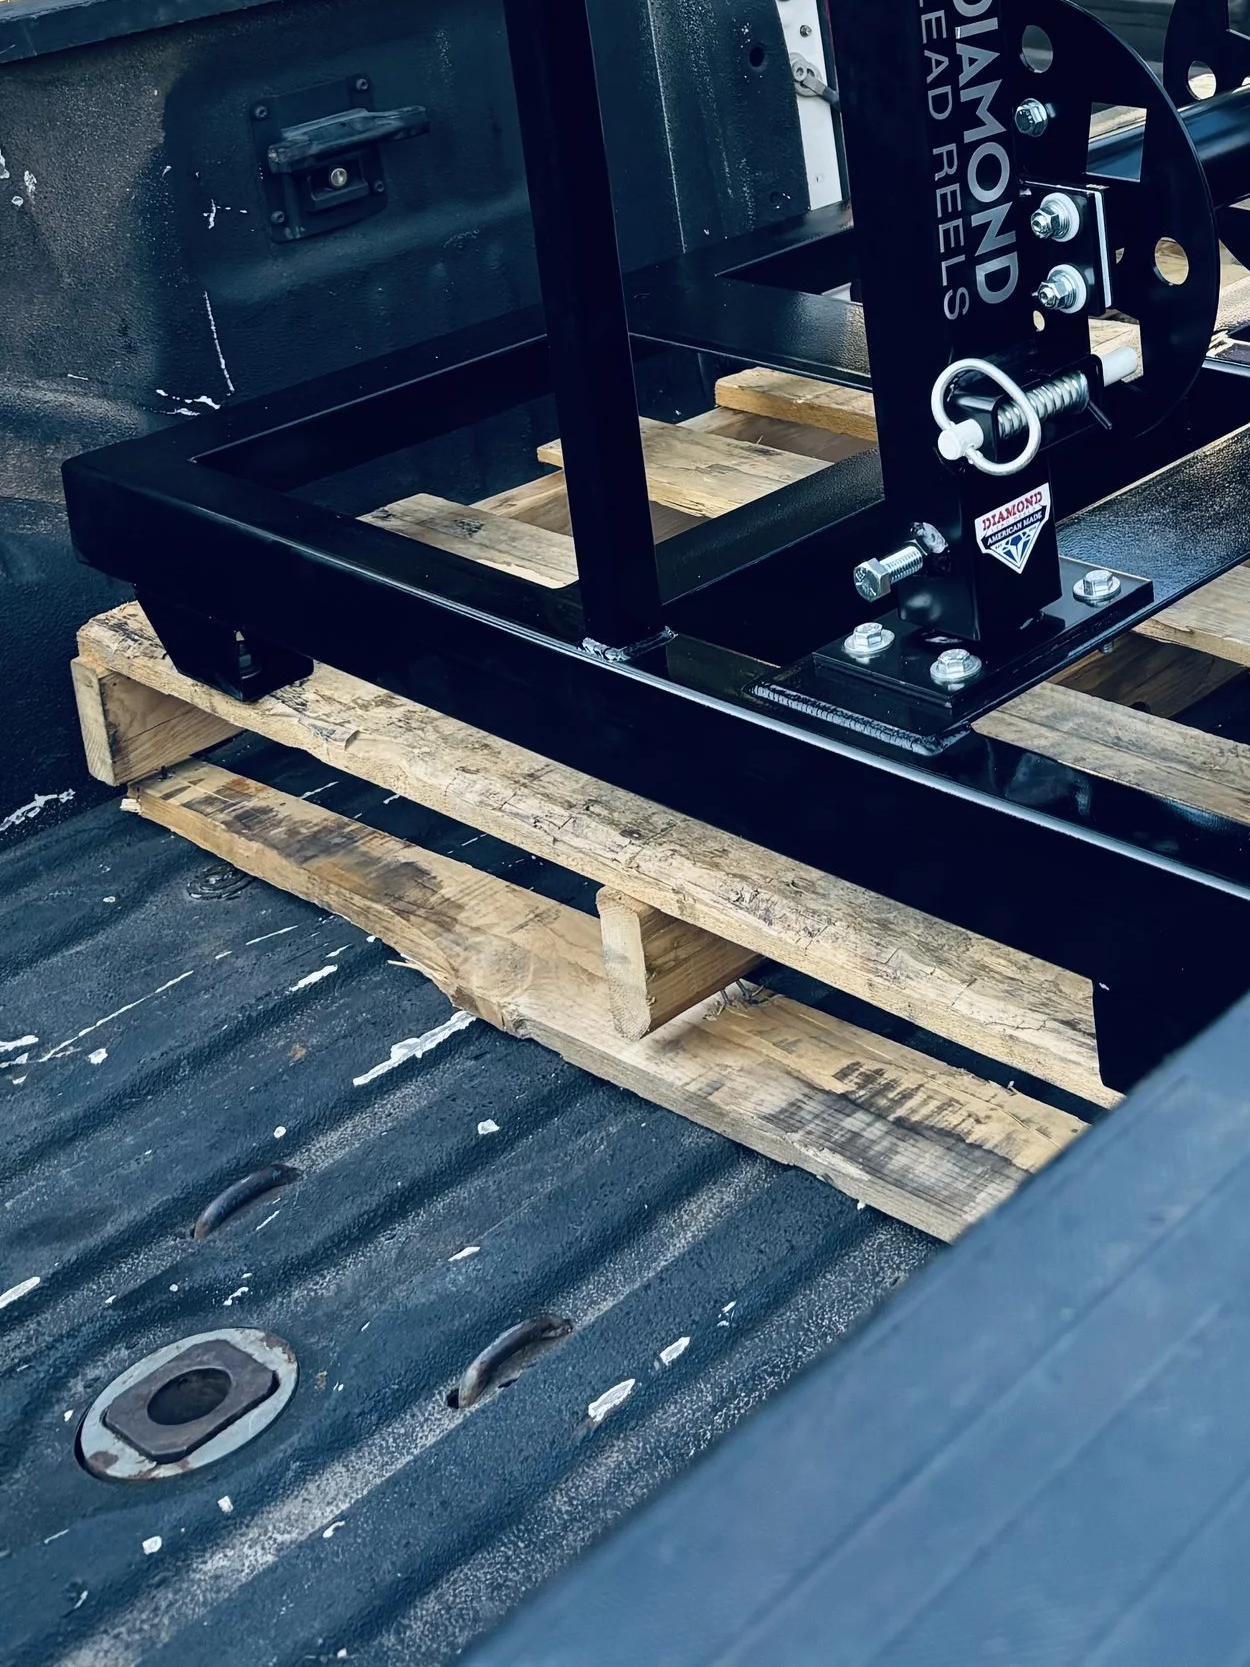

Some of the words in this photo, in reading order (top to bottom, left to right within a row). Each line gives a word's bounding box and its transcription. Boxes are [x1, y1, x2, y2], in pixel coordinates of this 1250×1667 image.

[932, 142, 969, 320] REELS
[982, 491, 1043, 531] DIAMOND
[987, 522, 1022, 546] AMERICAN
[1023, 511, 1043, 527] MADE
